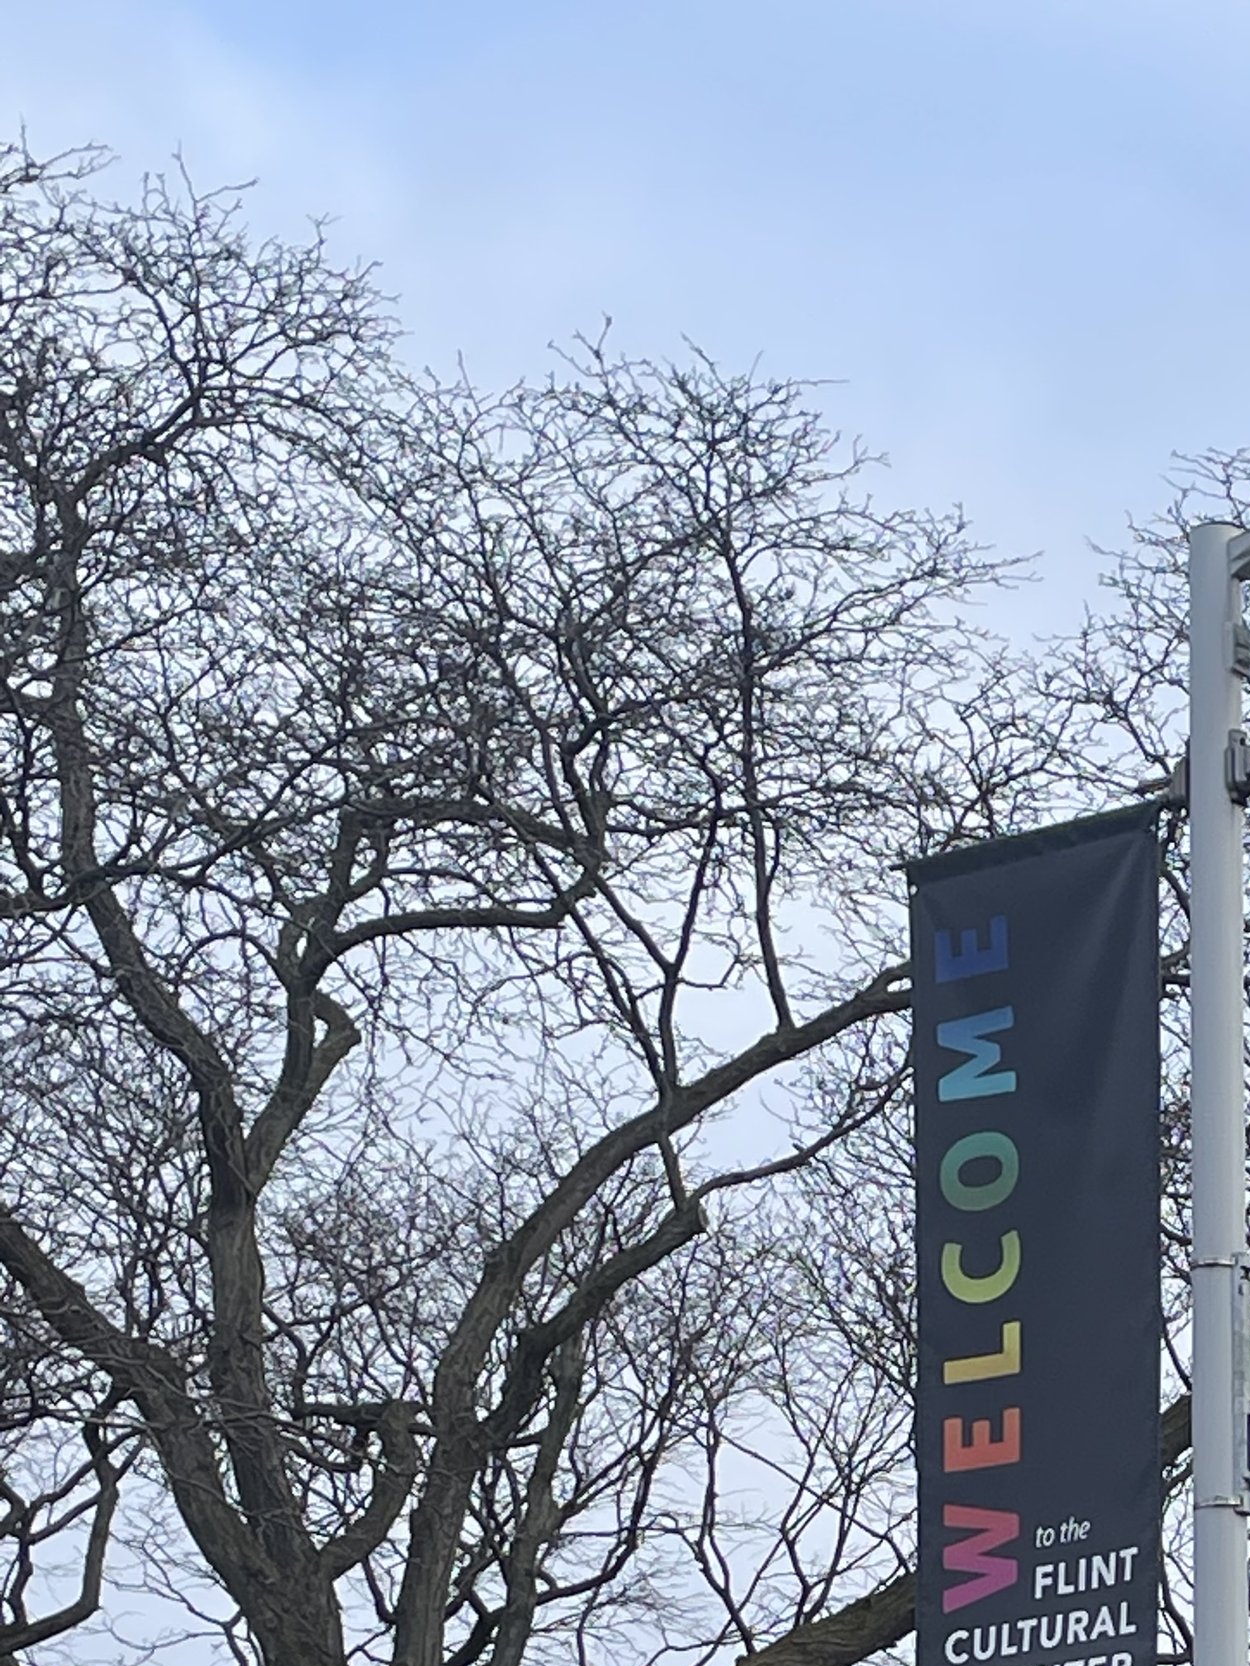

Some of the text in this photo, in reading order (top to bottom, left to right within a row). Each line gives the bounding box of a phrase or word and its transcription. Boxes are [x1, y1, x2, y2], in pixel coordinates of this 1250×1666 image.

[935, 914, 1021, 1613] WELCOME
[1035, 1517, 1091, 1548] to the
[1034, 1546, 1139, 1599] FLINT
[944, 1601, 1137, 1665] CULTURAL
